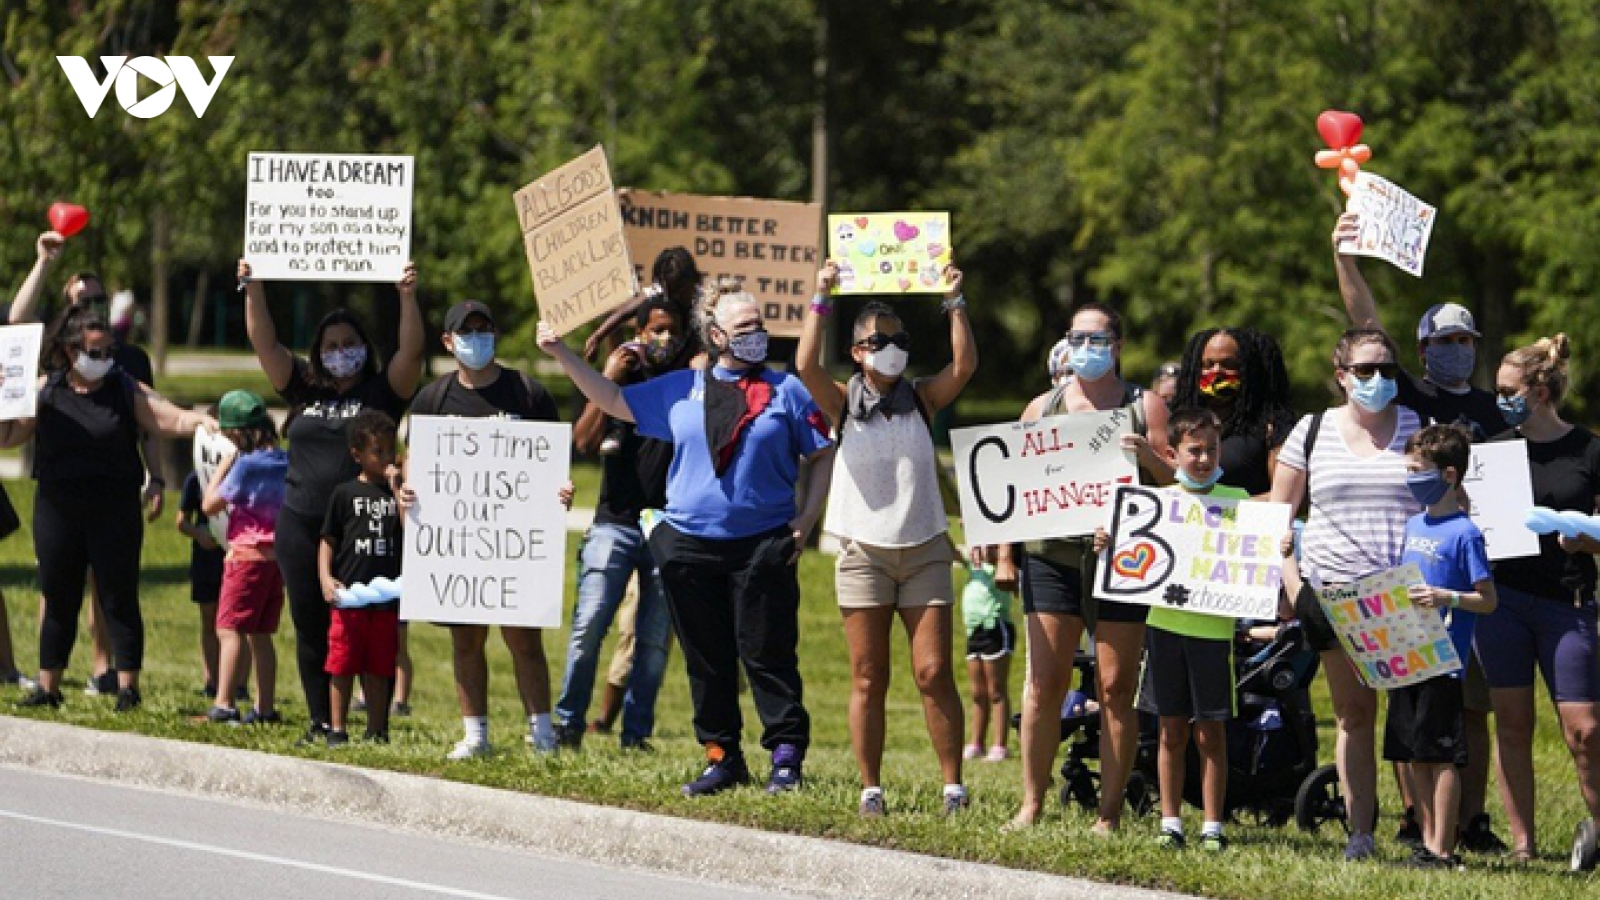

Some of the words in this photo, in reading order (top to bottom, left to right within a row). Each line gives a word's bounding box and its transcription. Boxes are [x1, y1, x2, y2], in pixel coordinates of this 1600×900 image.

[251, 157, 264, 182] I
[269, 158, 320, 183] HAVE
[321, 160, 337, 182] A
[338, 160, 404, 187] DREAM
[279, 203, 307, 220] you
[310, 202, 328, 218] to
[331, 204, 373, 220] stand
[378, 206, 399, 223] up
[521, 184, 558, 229] ALL
[621, 204, 690, 230] KNOW
[696, 214, 778, 237] BETTER
[279, 223, 304, 238] my
[310, 221, 339, 235] son
[532, 202, 608, 263] CHILDREN
[249, 238, 279, 253] and
[282, 239, 301, 254] to
[303, 237, 364, 256] protect
[368, 241, 401, 256] him
[694, 236, 727, 258] DO
[733, 240, 817, 263] BETTER
[288, 258, 309, 272] as
[314, 258, 326, 272] a
[536, 247, 590, 291] BLACK
[870, 258, 919, 275] LOVE
[545, 266, 628, 324] MATTER
[757, 277, 806, 296] THE
[489, 427, 551, 463] time
[427, 461, 462, 496] to
[472, 469, 531, 503] use
[1044, 463, 1064, 478] for
[452, 498, 507, 522] our
[368, 519, 385, 539] 4
[1200, 530, 1273, 558] LIVES
[1189, 556, 1282, 588] MATTER
[430, 571, 519, 610] VOICE
